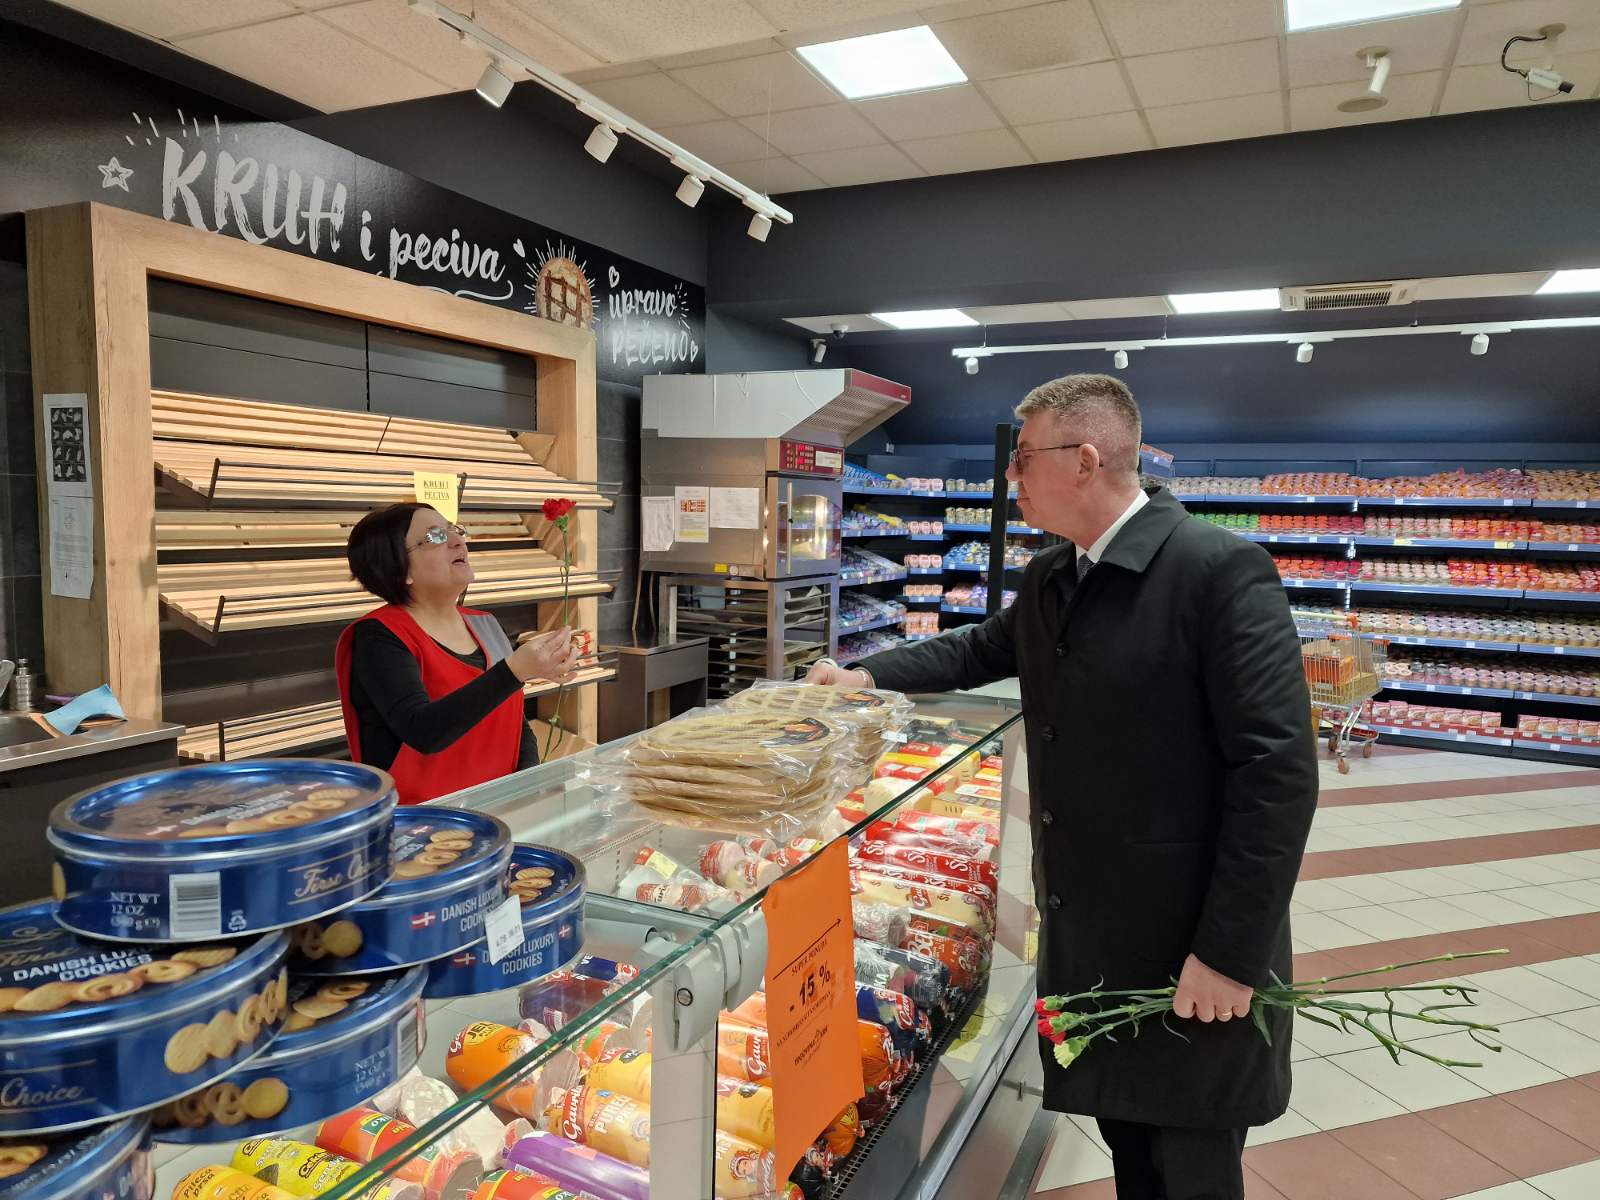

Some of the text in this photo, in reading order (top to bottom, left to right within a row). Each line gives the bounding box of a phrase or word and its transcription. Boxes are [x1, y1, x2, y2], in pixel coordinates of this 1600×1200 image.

[162, 136, 506, 283] KRUH i peciva
[608, 289, 678, 327] upravo
[612, 319, 689, 367] PEČENO
[441, 897, 478, 922] DANISH
[523, 932, 556, 955] LUXURY
[13, 955, 97, 982] DANISH
[58, 953, 153, 982] COOKIES
[502, 951, 543, 975] COOKIES
[800, 973, 816, 1007] 15
[819, 960, 831, 987] %
[1, 1077, 84, 1108] Choice
